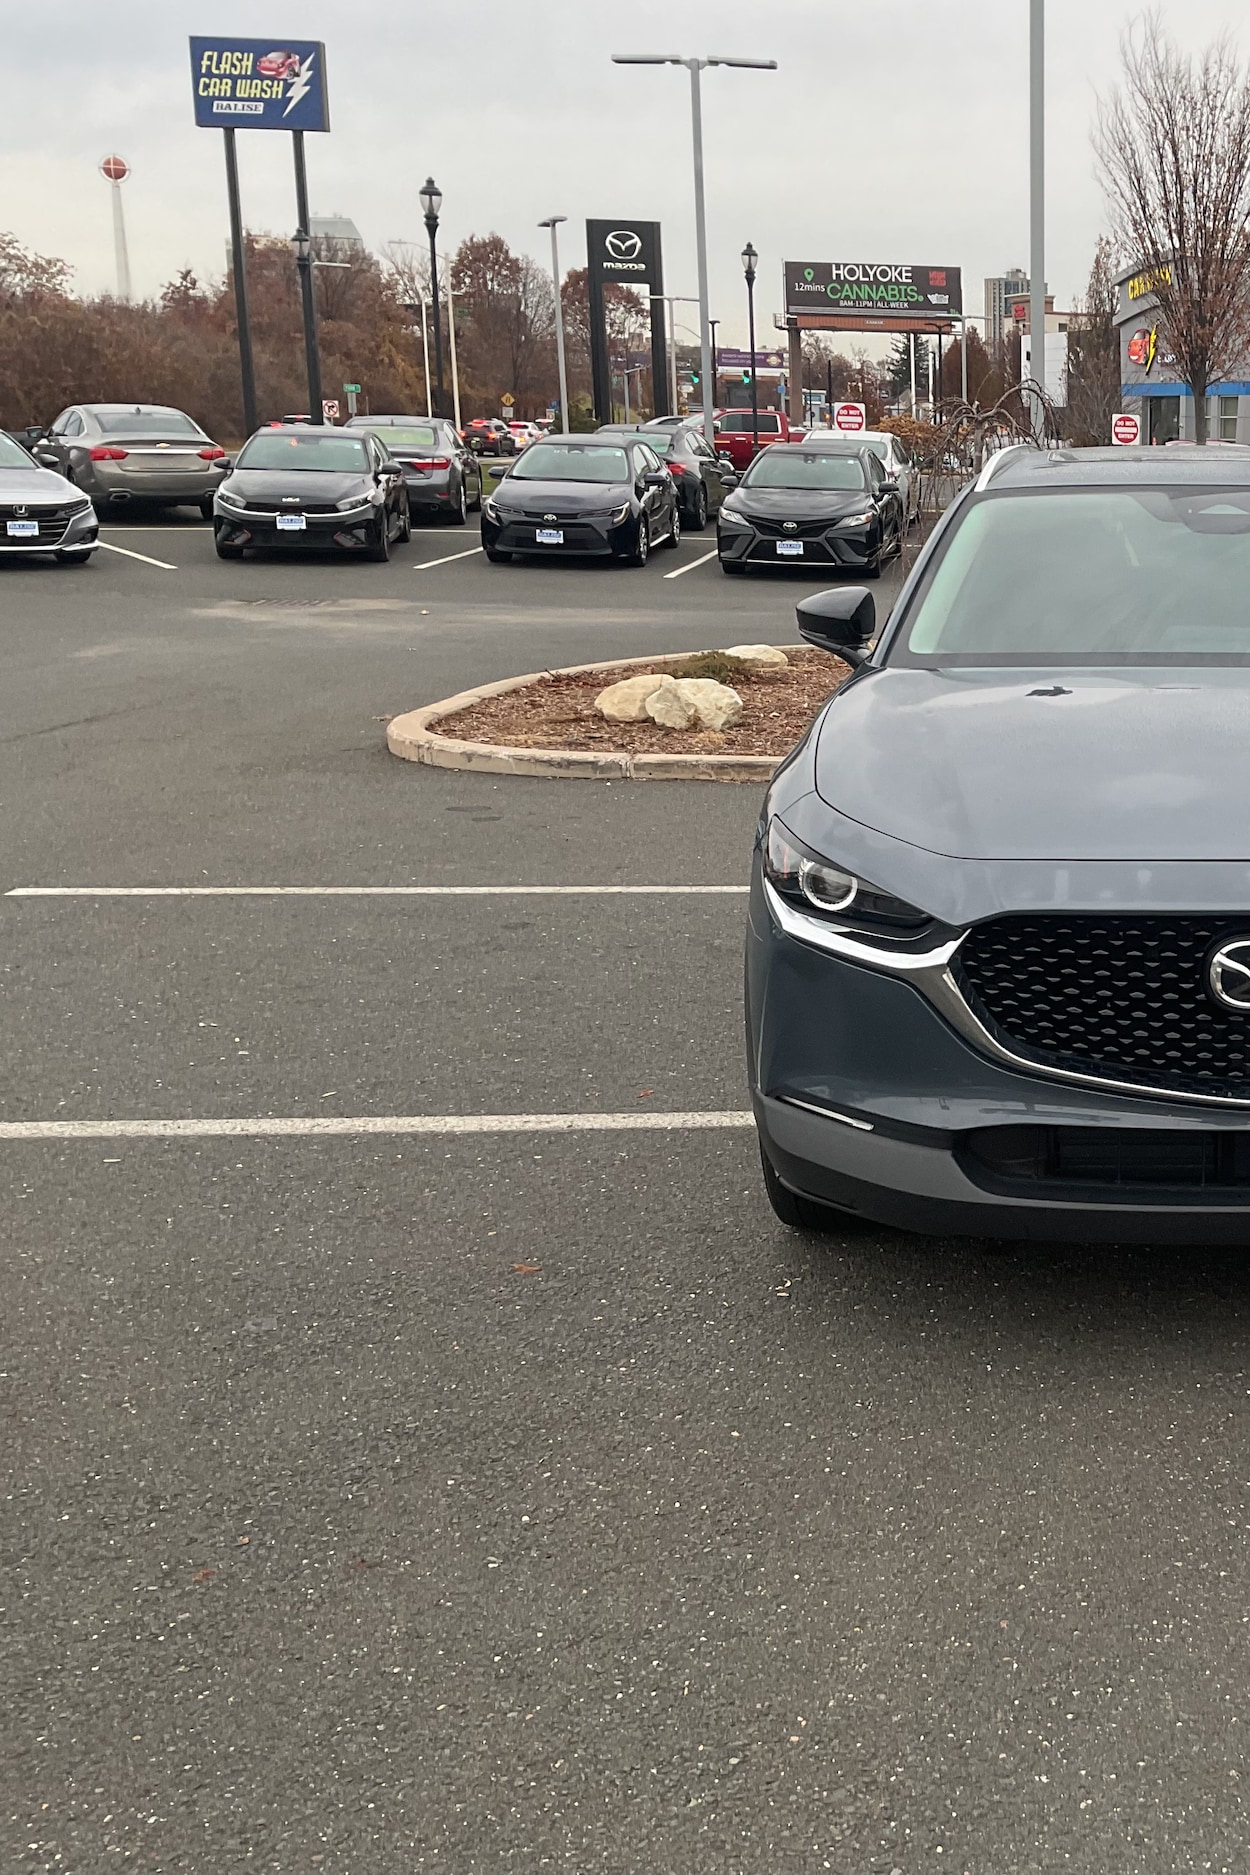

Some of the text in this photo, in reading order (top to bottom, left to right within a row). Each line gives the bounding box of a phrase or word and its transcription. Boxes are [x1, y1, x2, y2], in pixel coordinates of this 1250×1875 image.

[201, 51, 253, 75] FLASH
[198, 78, 284, 99] CAR WASH
[215, 102, 262, 112] BALISE
[603, 262, 646, 271] mazda
[832, 264, 912, 283] HOLYOKE
[794, 283, 825, 292] 12mins
[826, 283, 924, 302] CANNABIS.
[839, 300, 909, 309] 8AM-11PM ALL-WEEK
